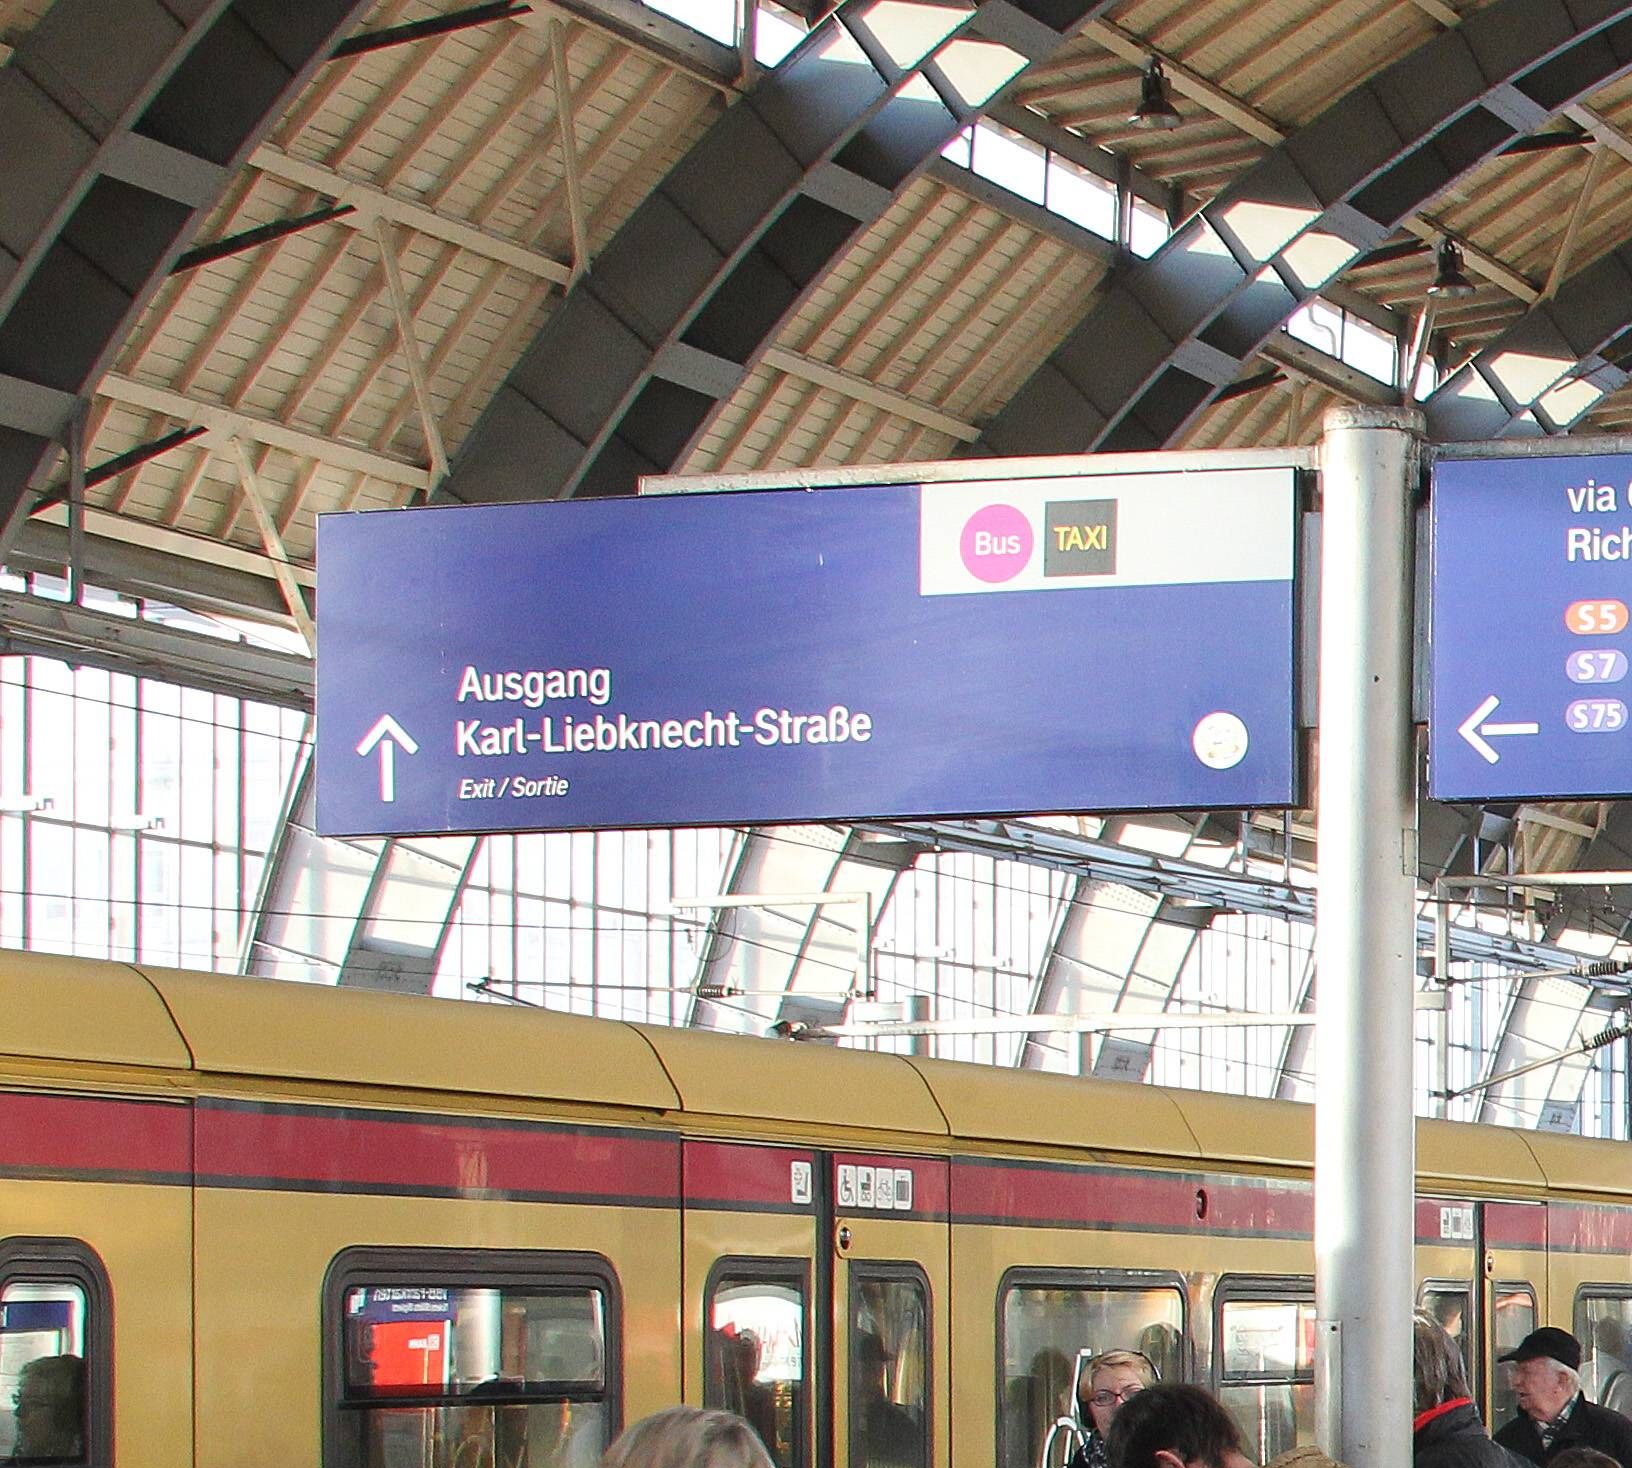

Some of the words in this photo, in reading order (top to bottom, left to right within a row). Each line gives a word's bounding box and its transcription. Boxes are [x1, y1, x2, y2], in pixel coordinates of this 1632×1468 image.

[1567, 480, 1617, 512] via
[976, 531, 1021, 556] Bus
[1054, 525, 1107, 551] TAXI
[457, 666, 611, 707] Ausgang
[1573, 703, 1622, 728] S75
[455, 706, 872, 757] Karl-Liebknecht-Straße
[459, 778, 496, 799] Exit
[497, 778, 508, 798] /
[511, 777, 569, 797] Sortie
